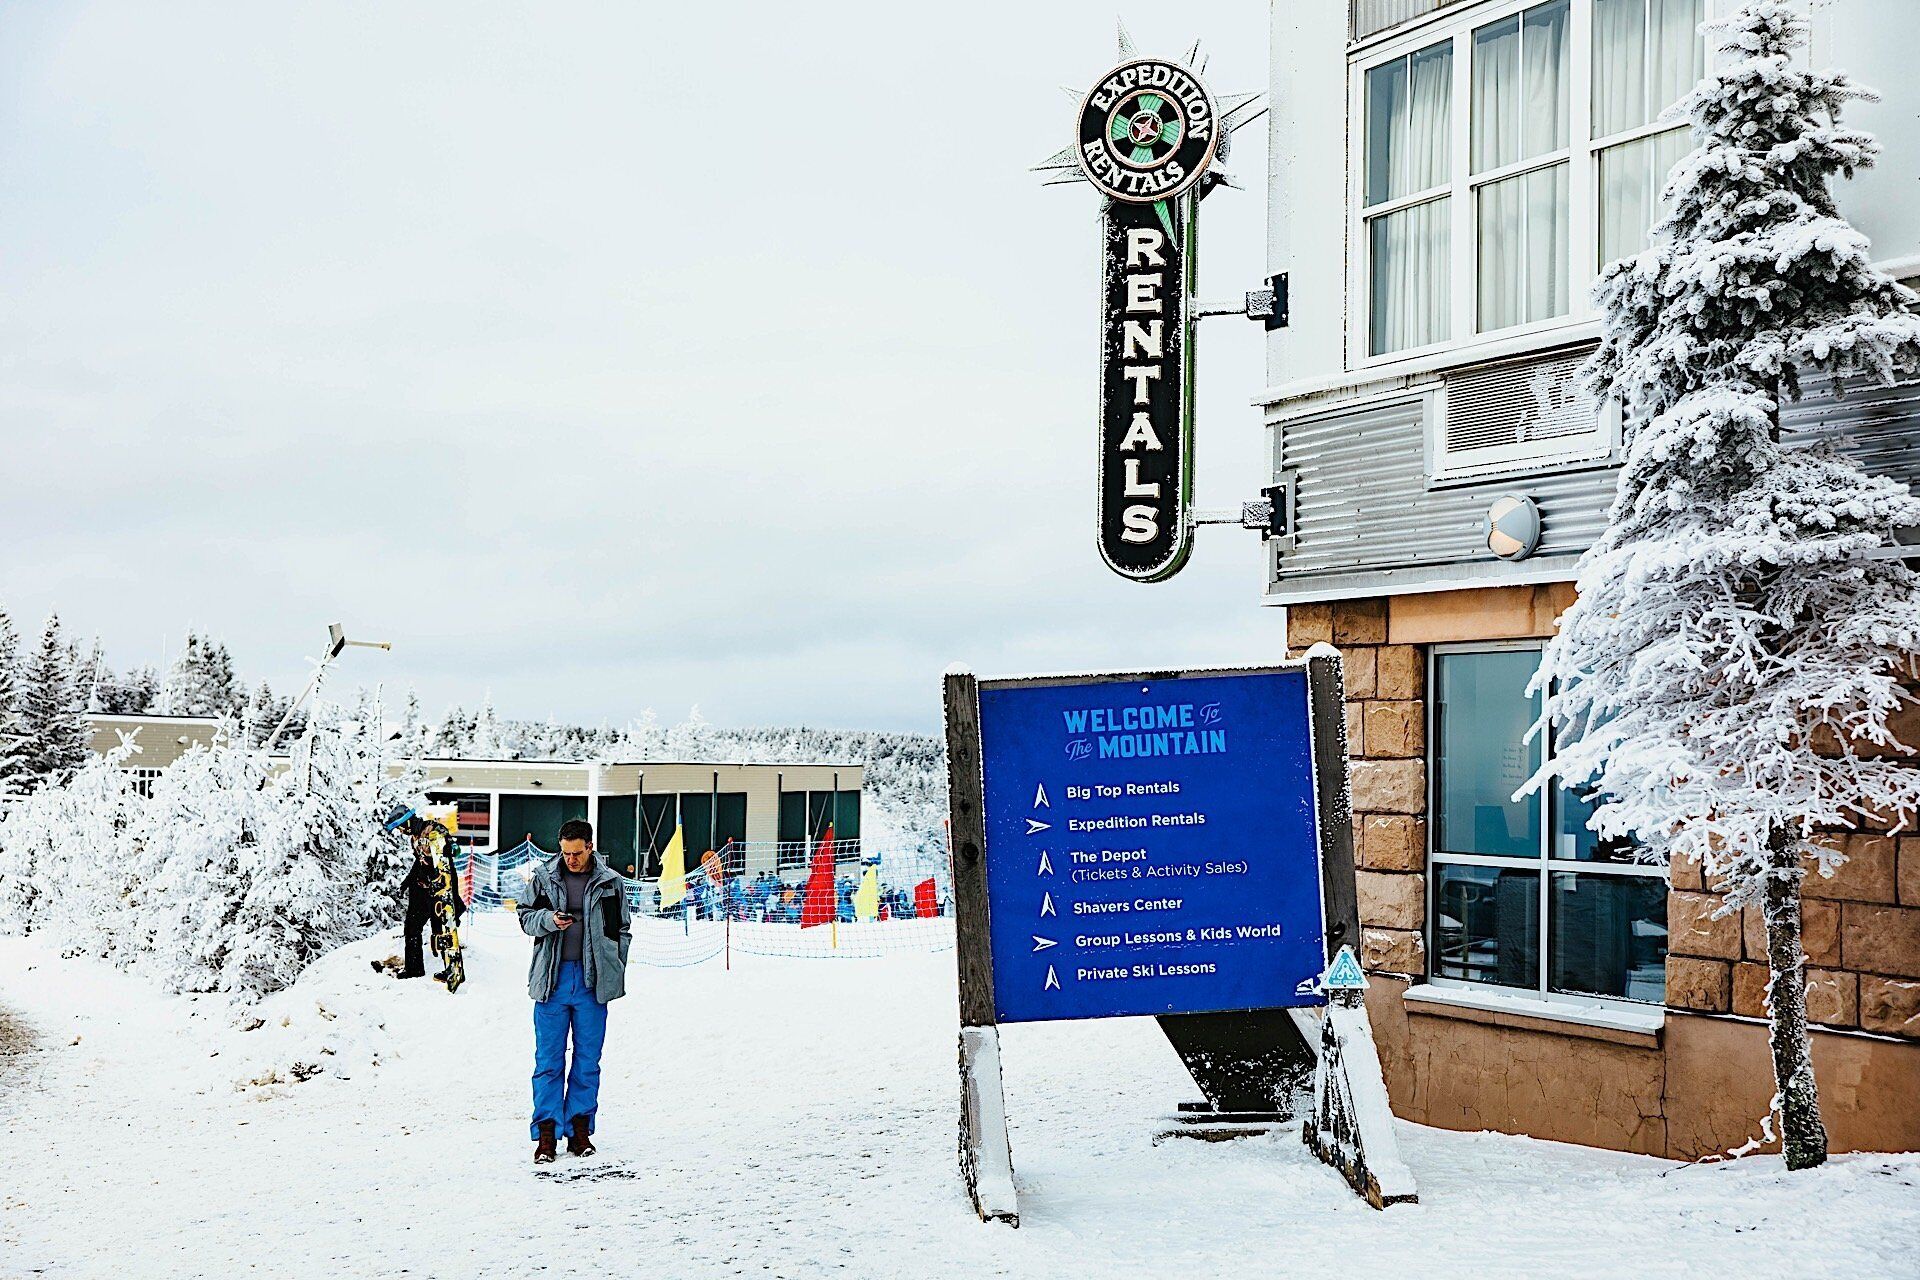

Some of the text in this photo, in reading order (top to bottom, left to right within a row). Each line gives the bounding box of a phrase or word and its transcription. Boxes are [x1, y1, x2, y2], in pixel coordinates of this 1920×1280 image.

[1091, 65, 1209, 141] EXPEDITION
[1084, 138, 1185, 194] RENTALS
[1120, 228, 1166, 544] RENTALS
[1063, 702, 1222, 734] WELCOME To
[1065, 730, 1226, 761] The MOUNTAIN
[1067, 781, 1179, 799] Big Top Rentals
[1069, 813, 1205, 832] Expedition Rentals
[1071, 849, 1146, 863] The Depot
[1072, 861, 1247, 883] (Tickets & Activity Sales)
[1074, 899, 1182, 914] Shavers Center
[1076, 925, 1280, 947] Group Lessons & Kids World
[1078, 964, 1216, 980] Private Ski Lessons
